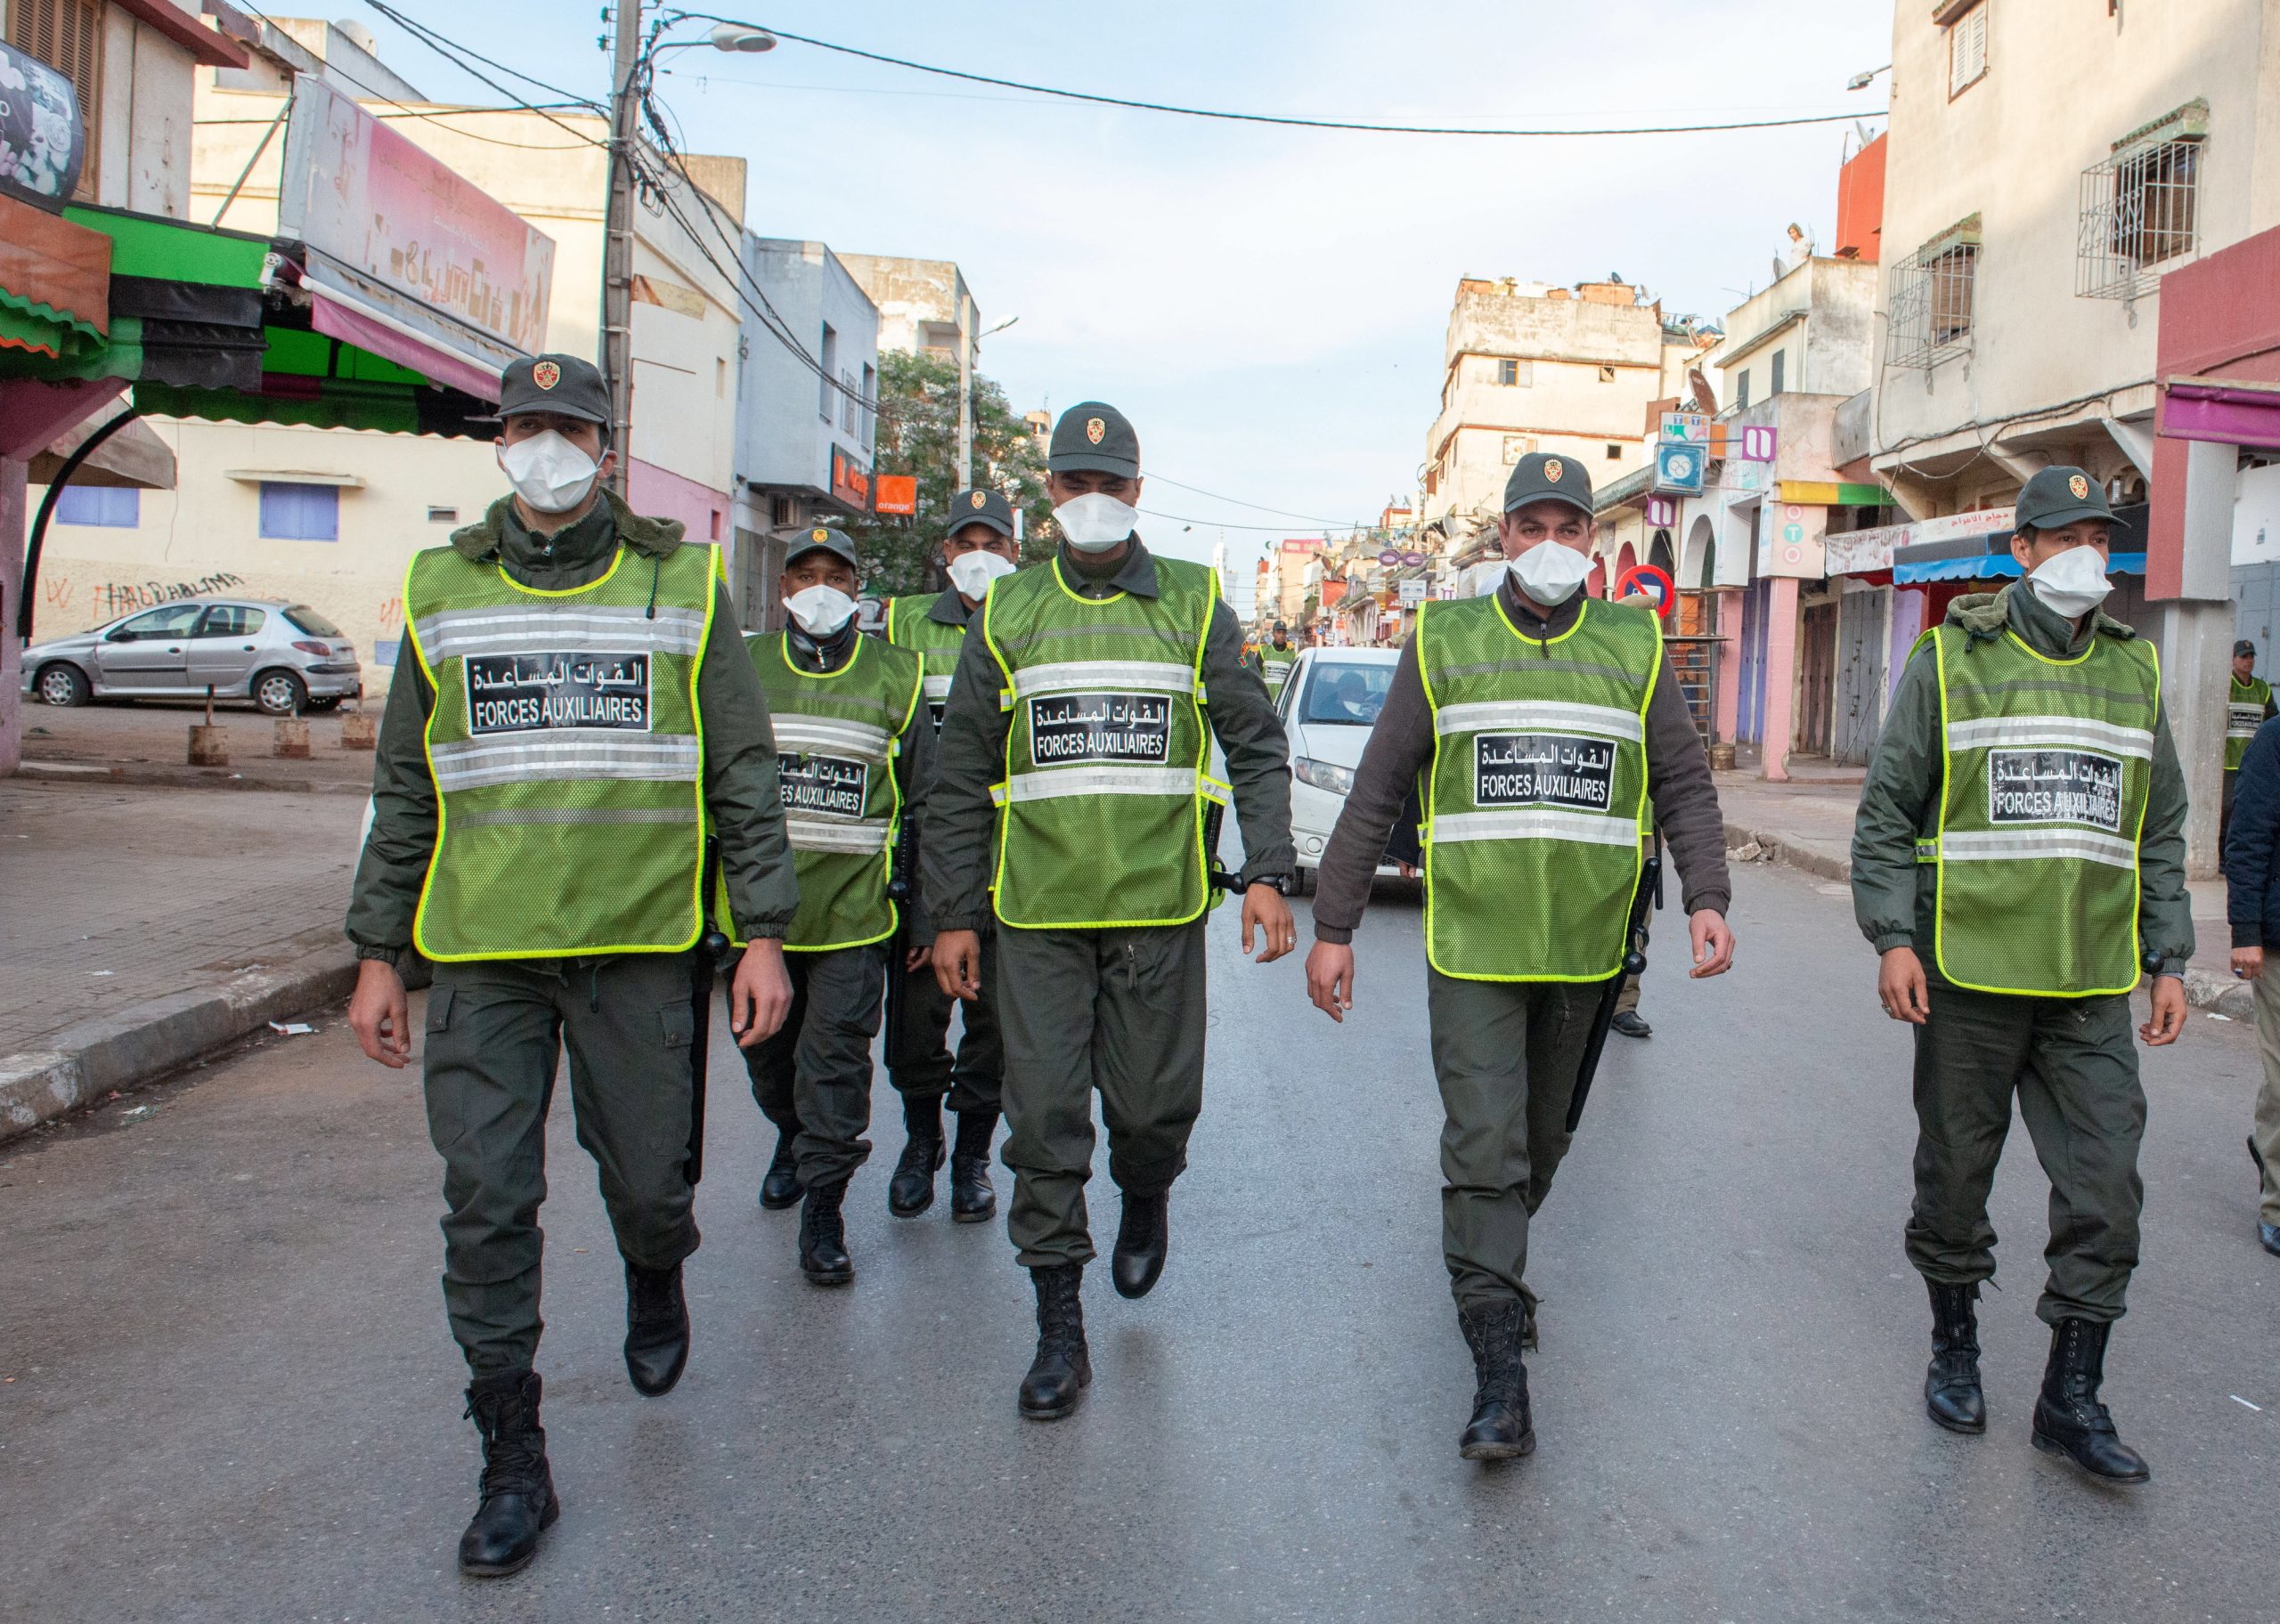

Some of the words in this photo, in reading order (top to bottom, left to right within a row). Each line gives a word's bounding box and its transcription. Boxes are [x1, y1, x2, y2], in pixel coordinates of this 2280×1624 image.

[878, 502, 909, 512] orange
[474, 661, 570, 690] المساعدة
[574, 661, 643, 691] القوات
[476, 697, 539, 727] FORCES
[541, 696, 643, 723] AUXILIAIRES
[1037, 702, 1111, 727] المساعدة
[1113, 702, 1165, 729] القوات
[1037, 732, 1084, 757] FORCES
[1087, 732, 1164, 755] AUXILIAIRES
[1482, 743, 1559, 765] المساعدة
[1560, 746, 1609, 773] القوات
[1997, 759, 2078, 781] المساعدة
[819, 765, 862, 787] القوات
[1481, 774, 1532, 798] FORCES
[1533, 774, 1607, 802] AUXILIAIRES
[2079, 763, 2118, 791] القوات
[794, 785, 860, 811] AUXILIAIRES
[1997, 791, 2051, 815] FORCES
[2053, 792, 2116, 822] AUXILIAIRES
